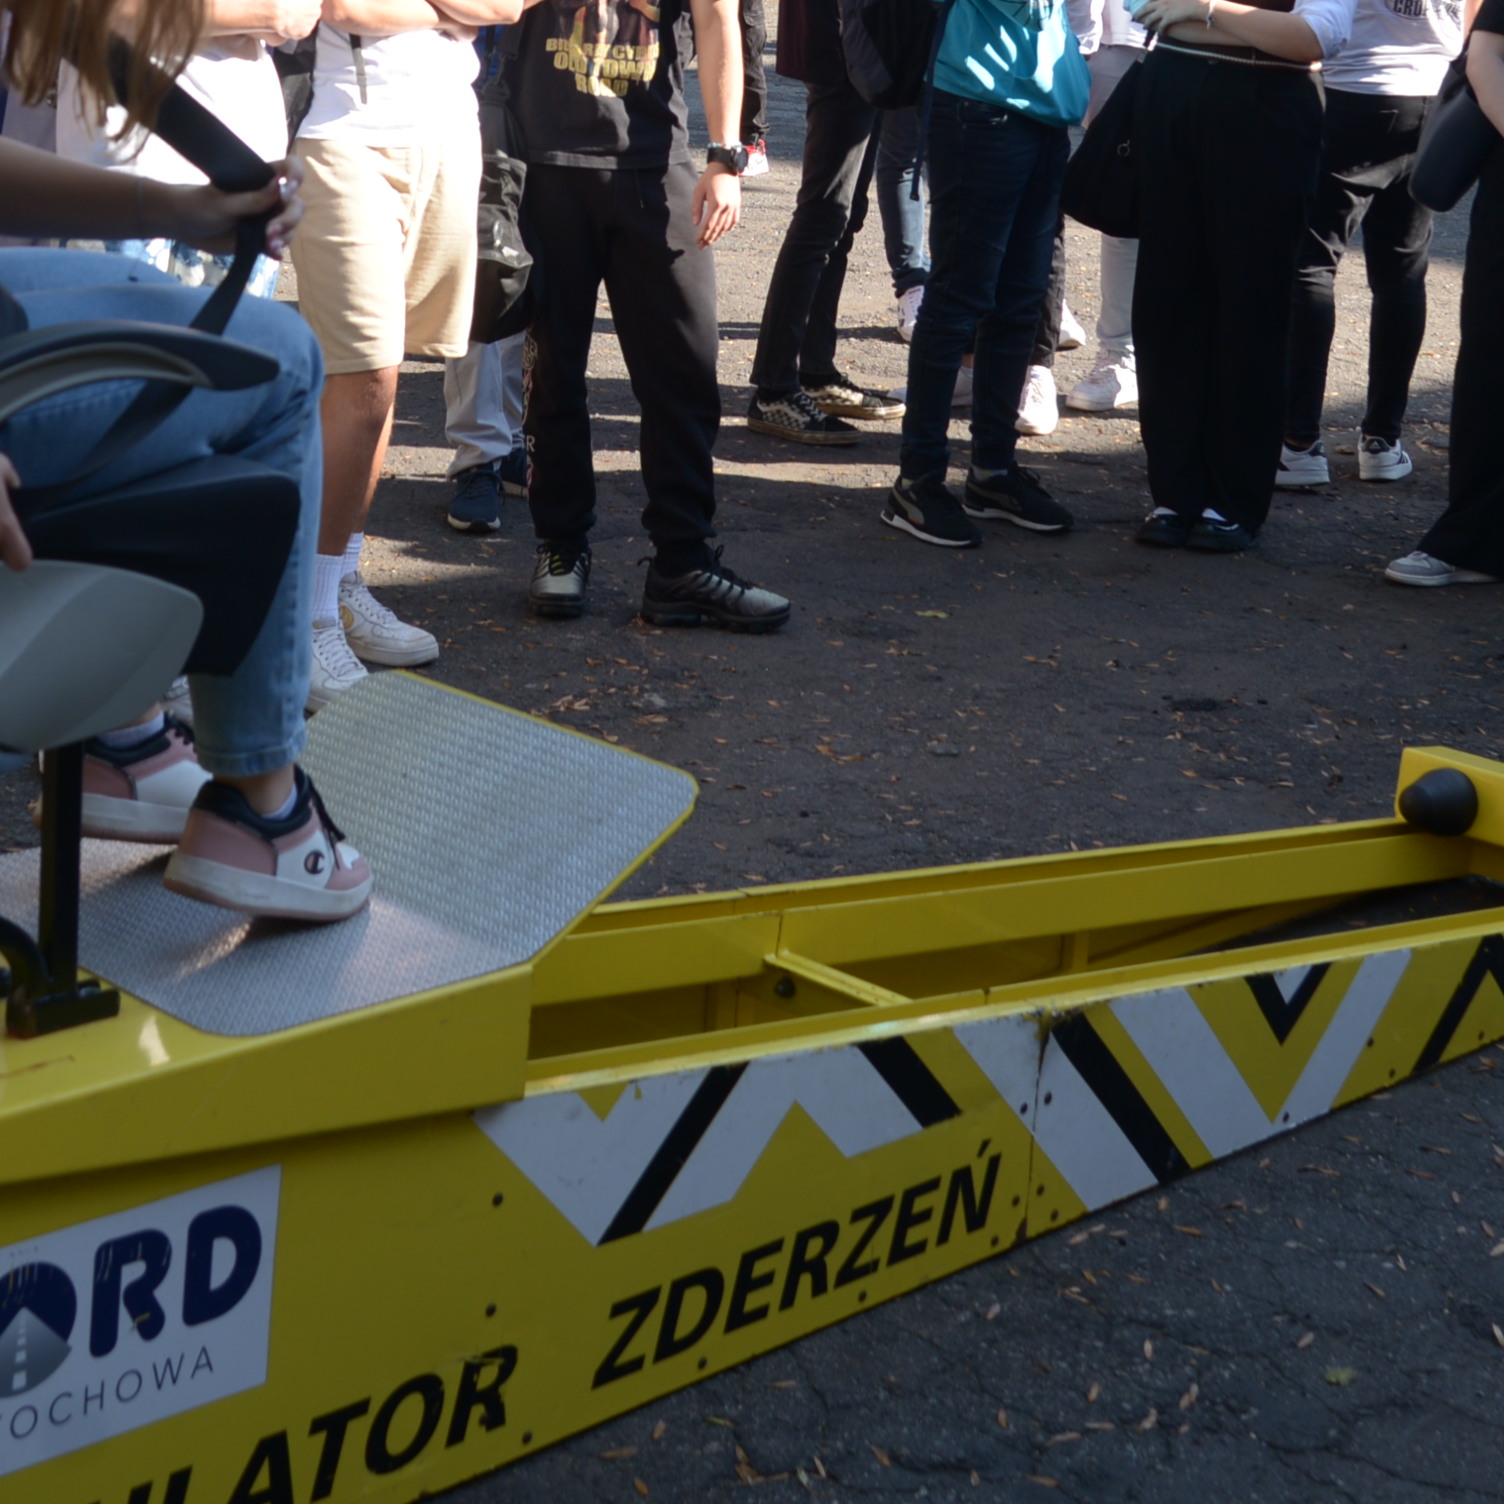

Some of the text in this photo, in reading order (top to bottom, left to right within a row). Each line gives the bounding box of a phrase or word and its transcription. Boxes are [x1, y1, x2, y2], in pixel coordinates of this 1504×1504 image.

[593, 57, 657, 82] TOWN
[575, 72, 629, 97] ROAD
[591, 1138, 1002, 1390] ZDERZEŃ
